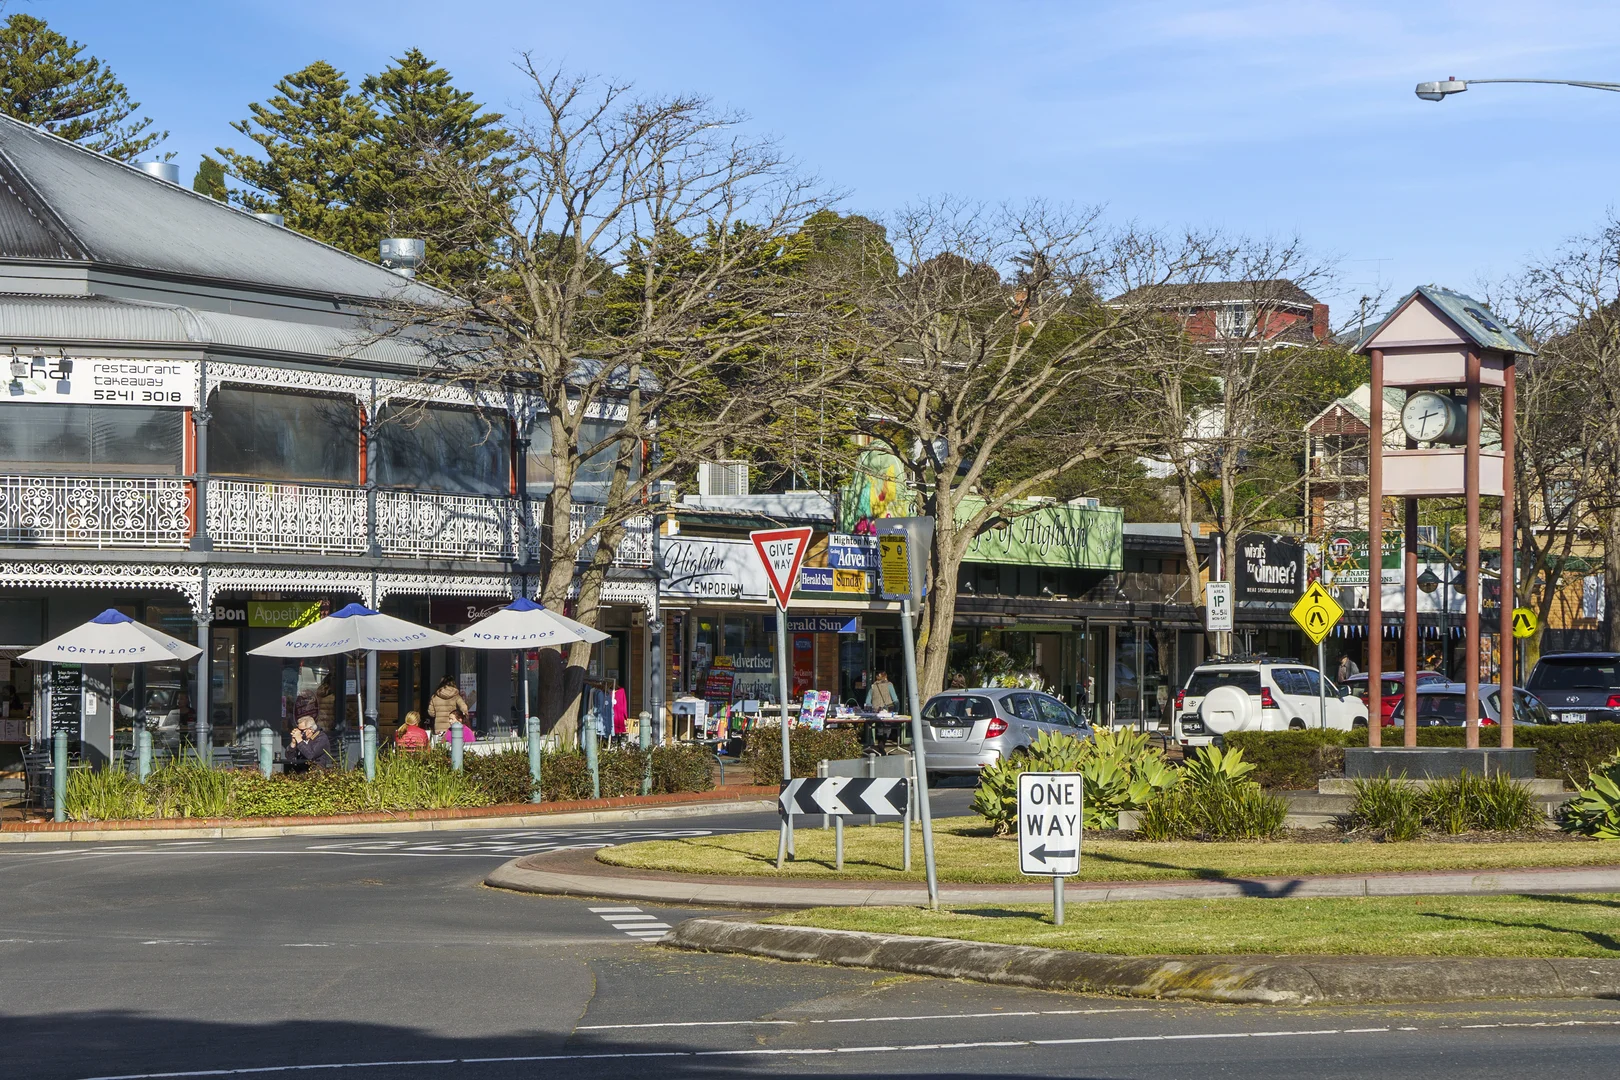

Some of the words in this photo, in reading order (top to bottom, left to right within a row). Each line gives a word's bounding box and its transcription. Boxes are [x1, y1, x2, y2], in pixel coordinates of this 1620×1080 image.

[93, 363, 181, 375] restaurant
[94, 375, 164, 387] takeaway
[94, 390, 134, 401] 5241
[142, 391, 182, 402] 3018
[833, 535, 861, 546] Highton
[769, 542, 794, 557] GIVE
[664, 542, 725, 586] Highton
[774, 558, 791, 570] WAY
[801, 571, 820, 585] Herald
[821, 573, 833, 585] Sun
[1254, 559, 1297, 584] dinner?
[694, 582, 744, 595] EMPORIUM
[836, 573, 864, 590] Sunday
[1213, 595, 1225, 607] 1P
[215, 606, 246, 620] Bon
[254, 606, 301, 624] Appetit
[787, 618, 816, 631] erald
[819, 618, 842, 631] Sun
[731, 653, 772, 668] Advertiser
[1030, 783, 1075, 805] ONE
[1027, 814, 1077, 836] WAY
